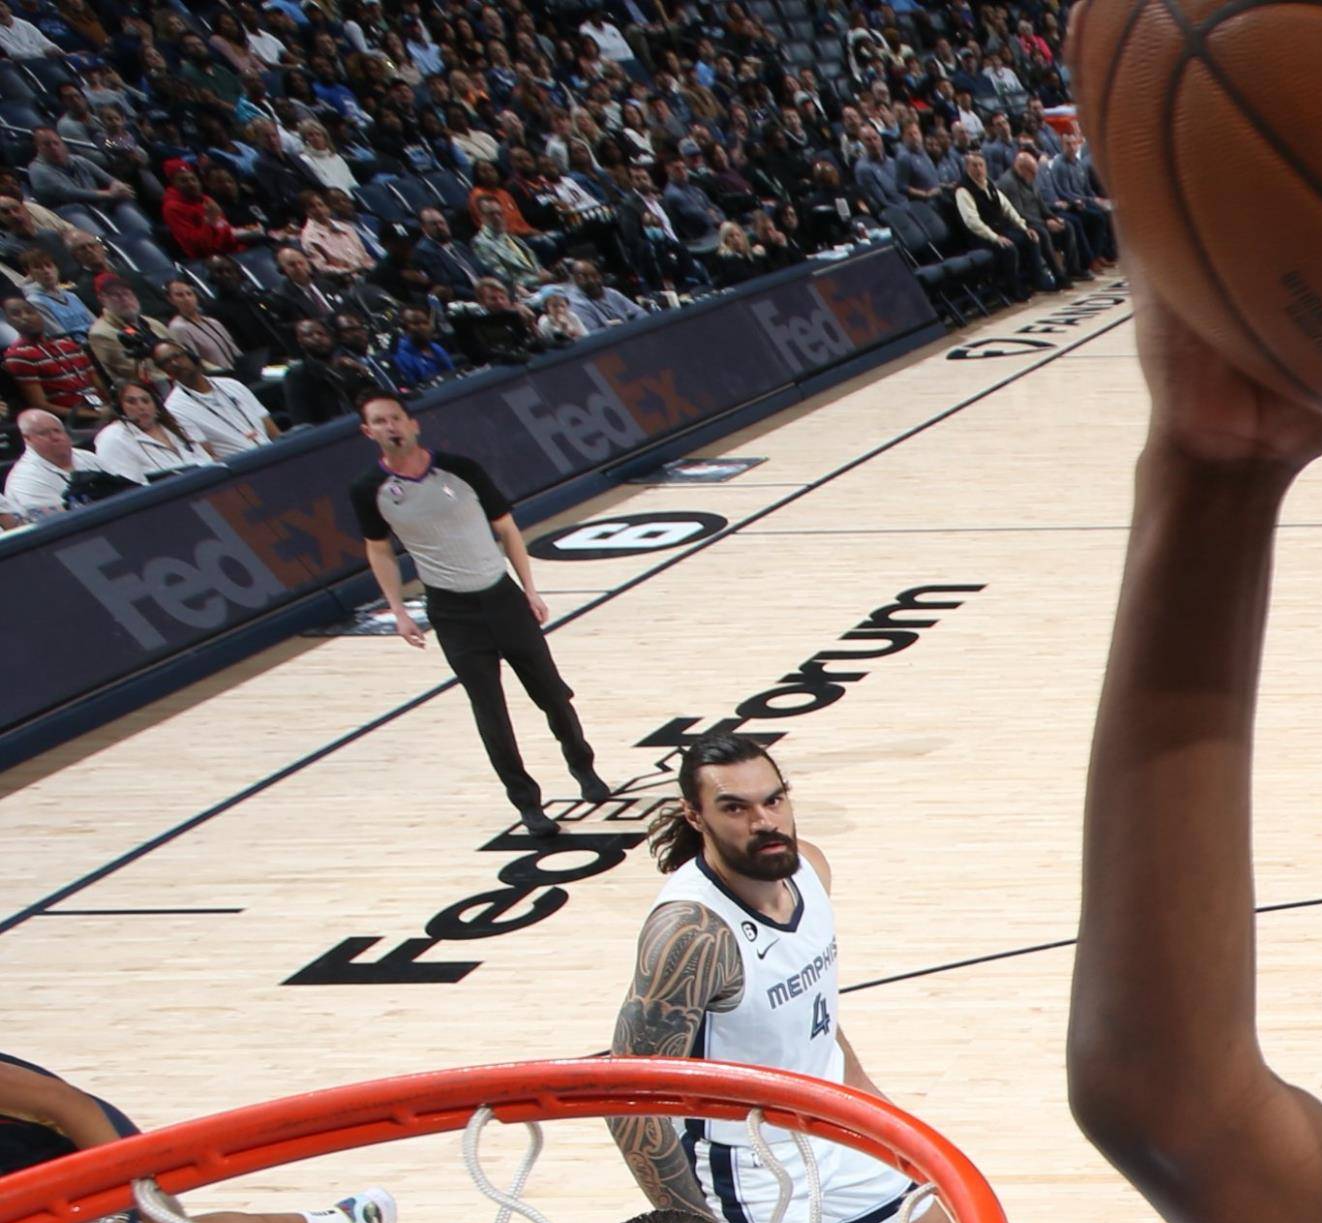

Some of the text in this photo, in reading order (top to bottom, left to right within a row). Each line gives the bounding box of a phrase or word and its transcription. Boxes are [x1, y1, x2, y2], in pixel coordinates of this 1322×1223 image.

[749, 275, 894, 374] FedEx
[502, 351, 700, 476] FedEx
[54, 484, 369, 651] FedEx
[810, 992, 831, 1041] 4
